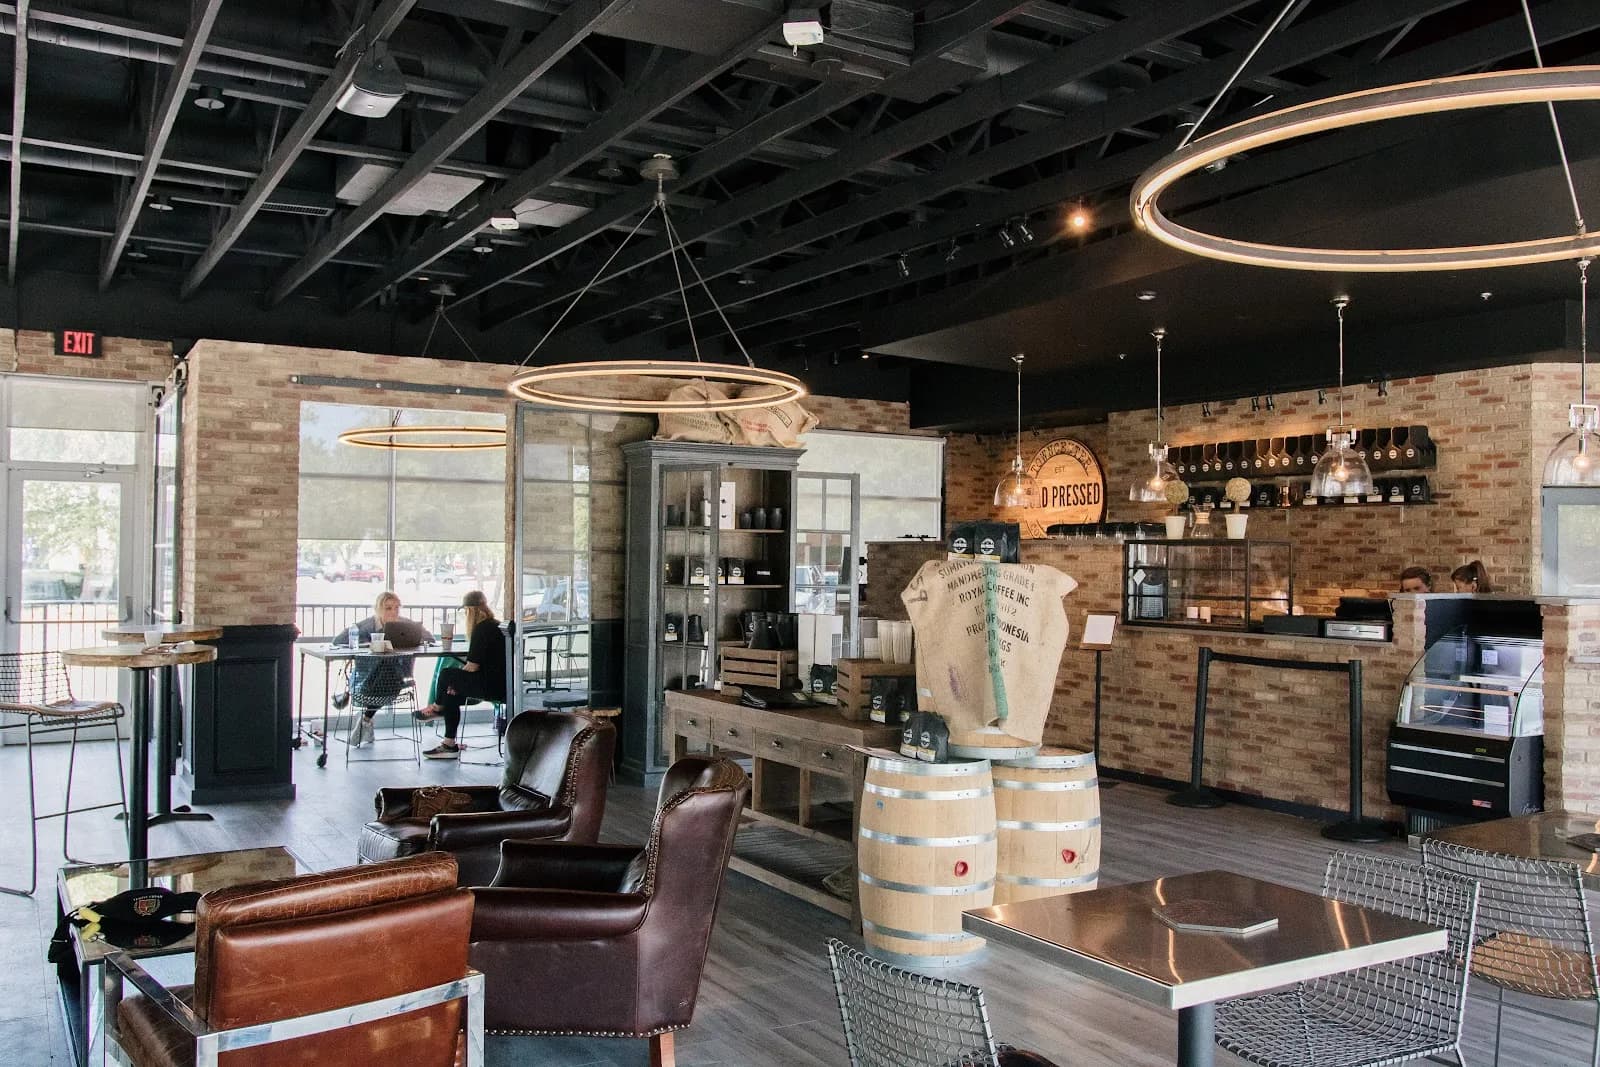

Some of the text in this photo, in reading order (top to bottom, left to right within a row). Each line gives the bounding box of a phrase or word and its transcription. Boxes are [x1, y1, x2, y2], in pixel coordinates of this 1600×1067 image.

[63, 331, 96, 354] EXIT
[1052, 482, 1100, 508] PRESSED
[958, 581, 1031, 607] ROYAL COFFEE INC
